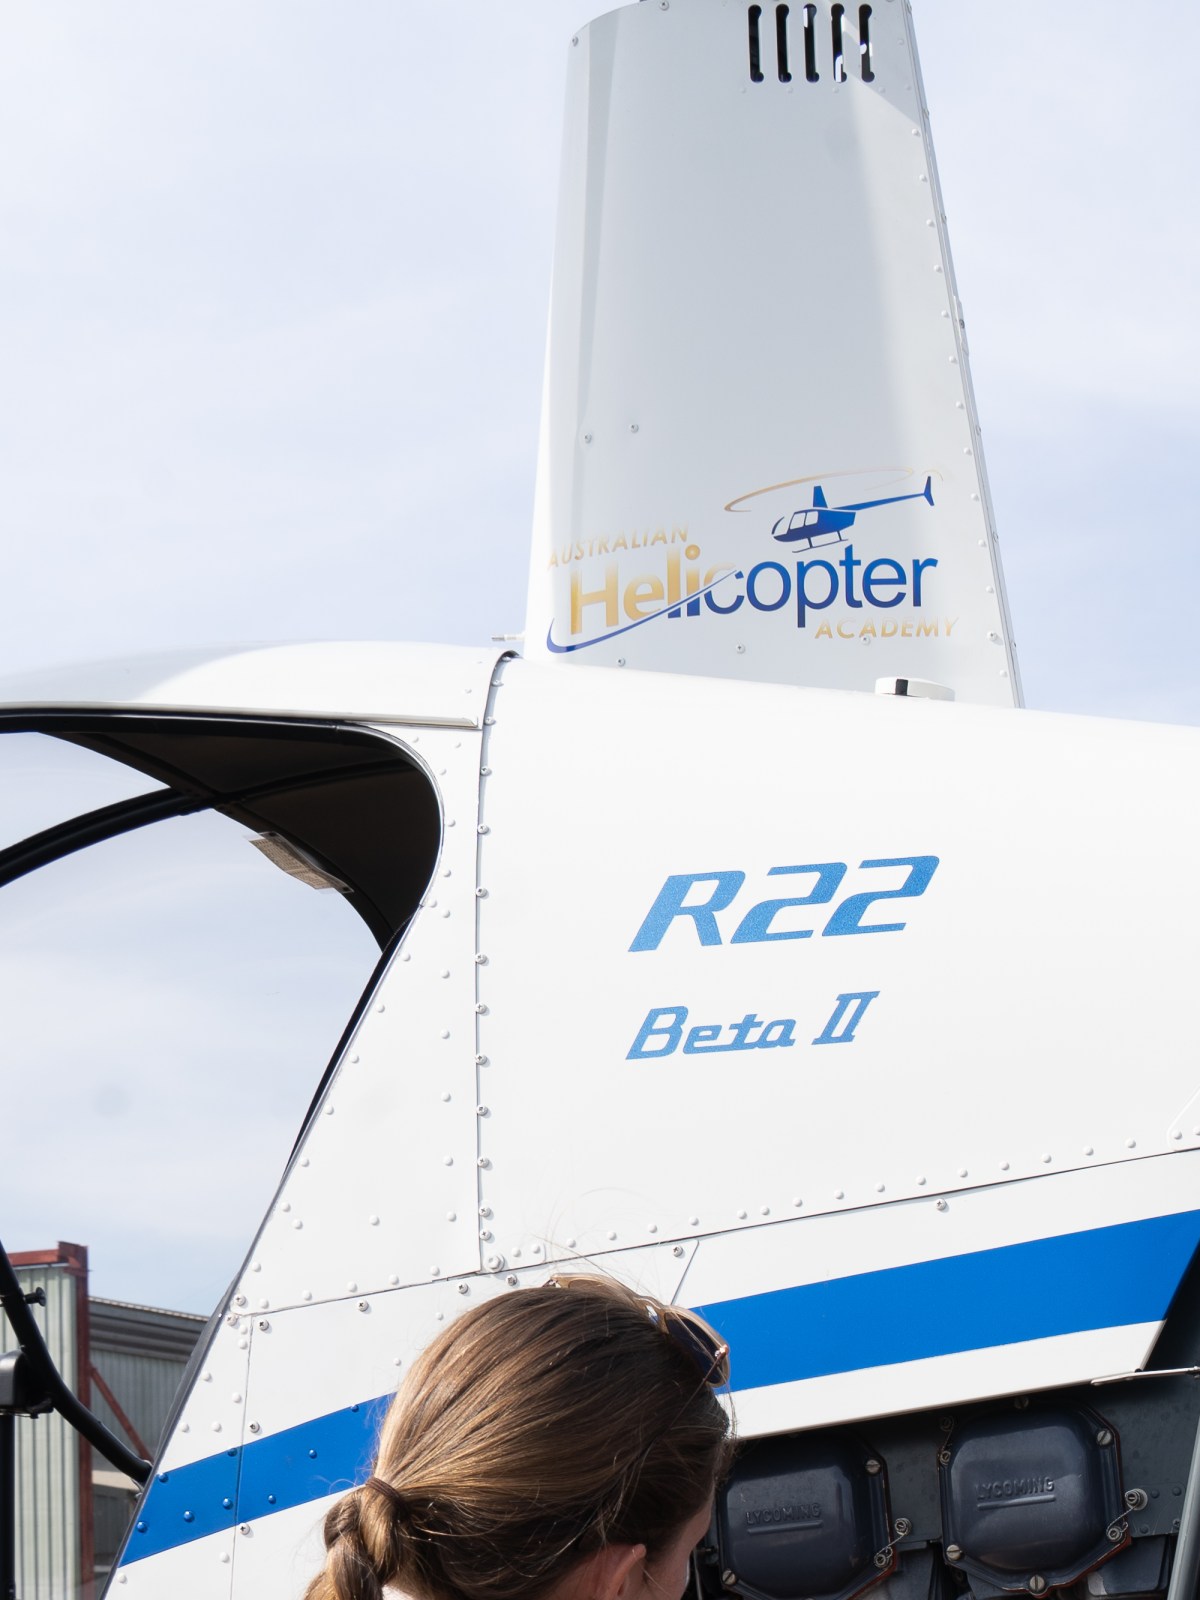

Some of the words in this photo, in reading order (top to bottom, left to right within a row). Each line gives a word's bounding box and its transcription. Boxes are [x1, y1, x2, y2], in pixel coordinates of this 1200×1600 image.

[547, 521, 689, 570] AUSTRALIAN
[570, 544, 938, 635] Helicopter
[815, 616, 959, 639] ACADEMY
[627, 855, 940, 952] R22
[625, 1006, 797, 1060] Beta
[811, 990, 881, 1045] II
[976, 1477, 1054, 1500] LYCOMING
[746, 1503, 821, 1525] LYCOMING
